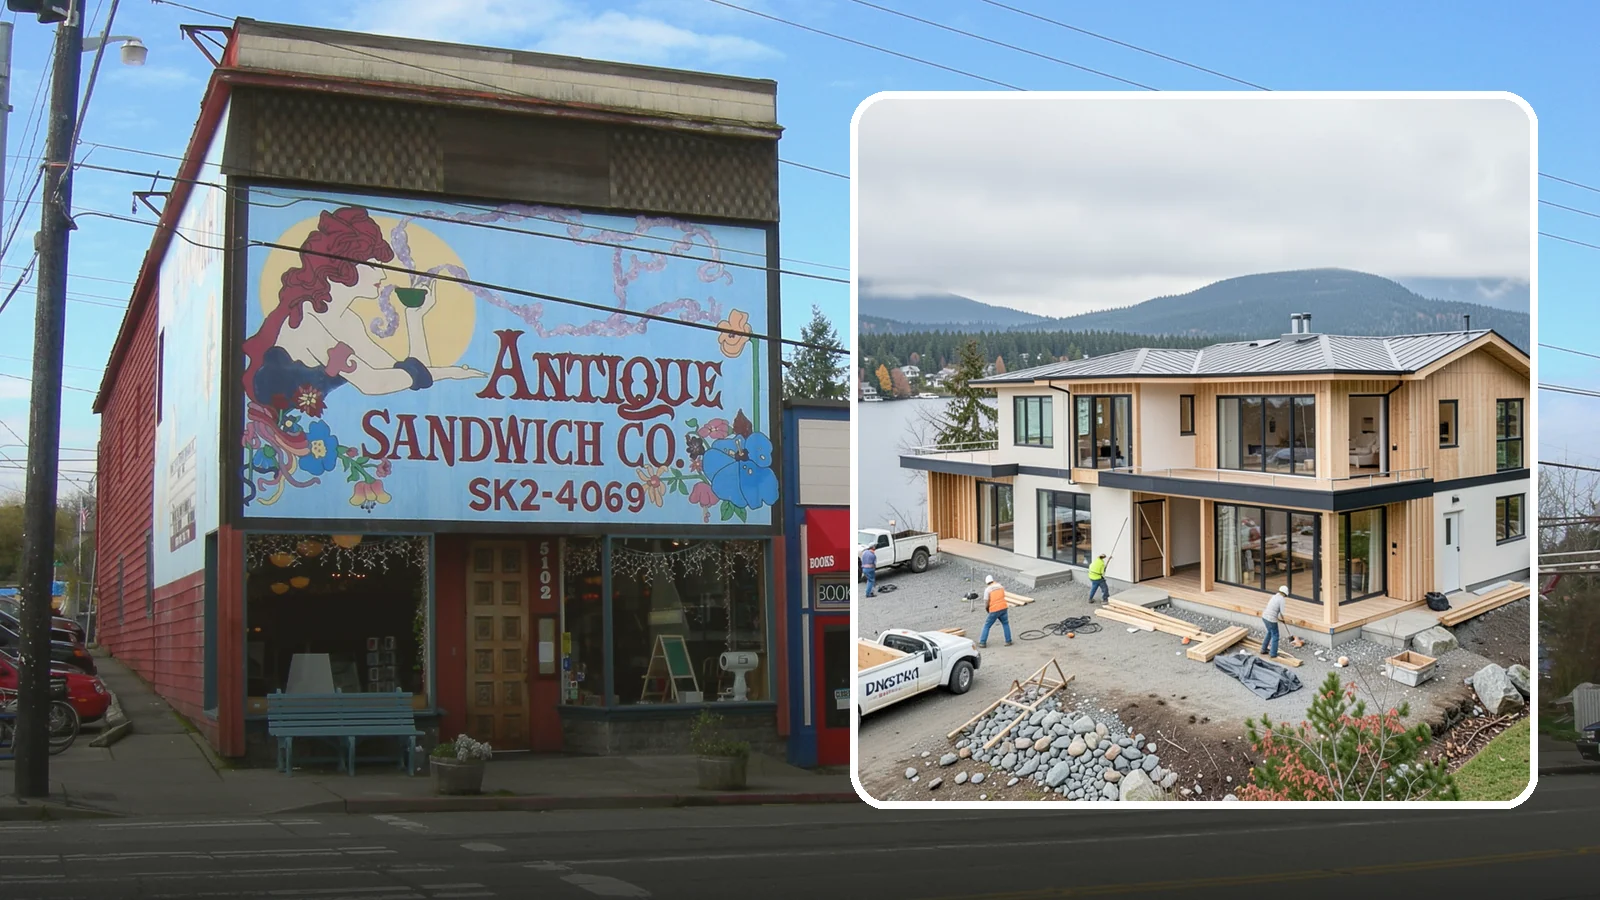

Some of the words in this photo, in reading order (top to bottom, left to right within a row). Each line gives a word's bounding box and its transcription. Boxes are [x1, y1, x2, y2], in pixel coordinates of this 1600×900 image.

[475, 329, 724, 421] ANTIQUE
[361, 408, 604, 467] SANDWICH
[617, 421, 685, 469] CO.
[468, 477, 646, 513] SK2-4069
[540, 541, 552, 600] 5102
[809, 554, 835, 569] BOOKS
